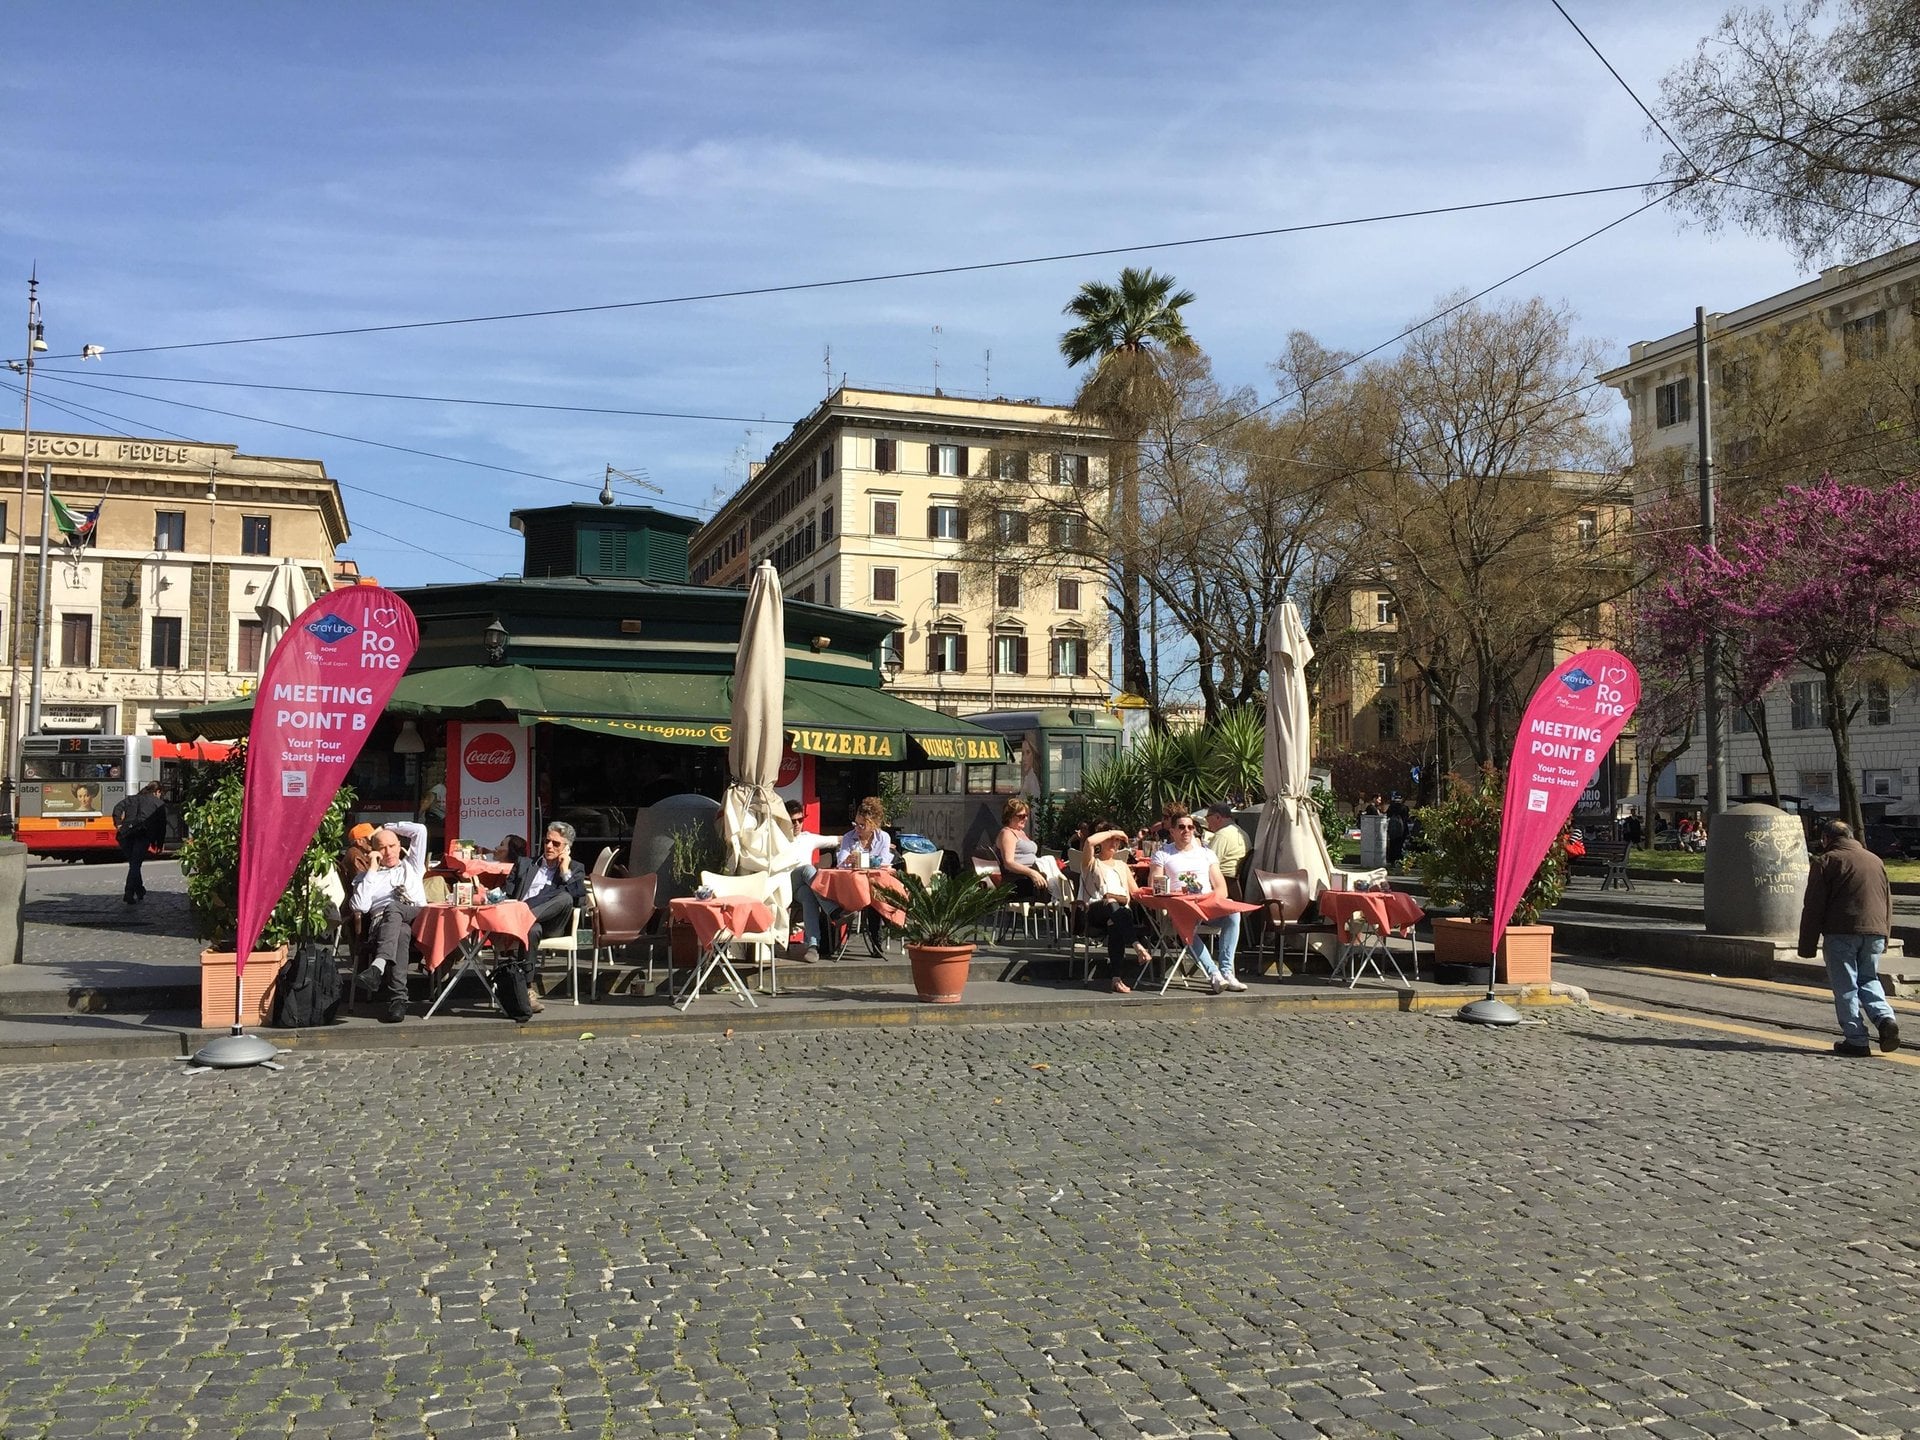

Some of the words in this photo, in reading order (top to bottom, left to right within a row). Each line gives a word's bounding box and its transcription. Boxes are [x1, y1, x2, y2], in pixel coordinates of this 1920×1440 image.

[28, 438, 99, 458] SECOLI
[118, 444, 188, 464] FEDELE
[362, 631, 395, 652] Ro
[360, 653, 401, 669] me
[273, 684, 373, 705] MEETING
[1597, 683, 1621, 703] Ro
[1594, 701, 1625, 717] me
[277, 710, 347, 730] POINT
[352, 713, 367, 731] B
[1531, 719, 1601, 743] MEETING
[69, 739, 81, 751] 32
[287, 738, 313, 748] Your
[315, 739, 341, 749] Tour
[786, 729, 892, 756] PIZZERIA
[967, 740, 1001, 759] BAR
[281, 752, 313, 762] Starts
[316, 753, 345, 763] Here!
[466, 749, 514, 765] Coca-Cola
[1531, 740, 1582, 761] POINT
[1584, 748, 1595, 763] B
[1537, 763, 1556, 773] Your
[1558, 766, 1577, 776] Tour
[1532, 773, 1555, 784] Starts
[1556, 776, 1579, 788] Here!
[20, 785, 40, 793] atac
[106, 785, 124, 793] 5373
[460, 808, 525, 819] ghiacciata
